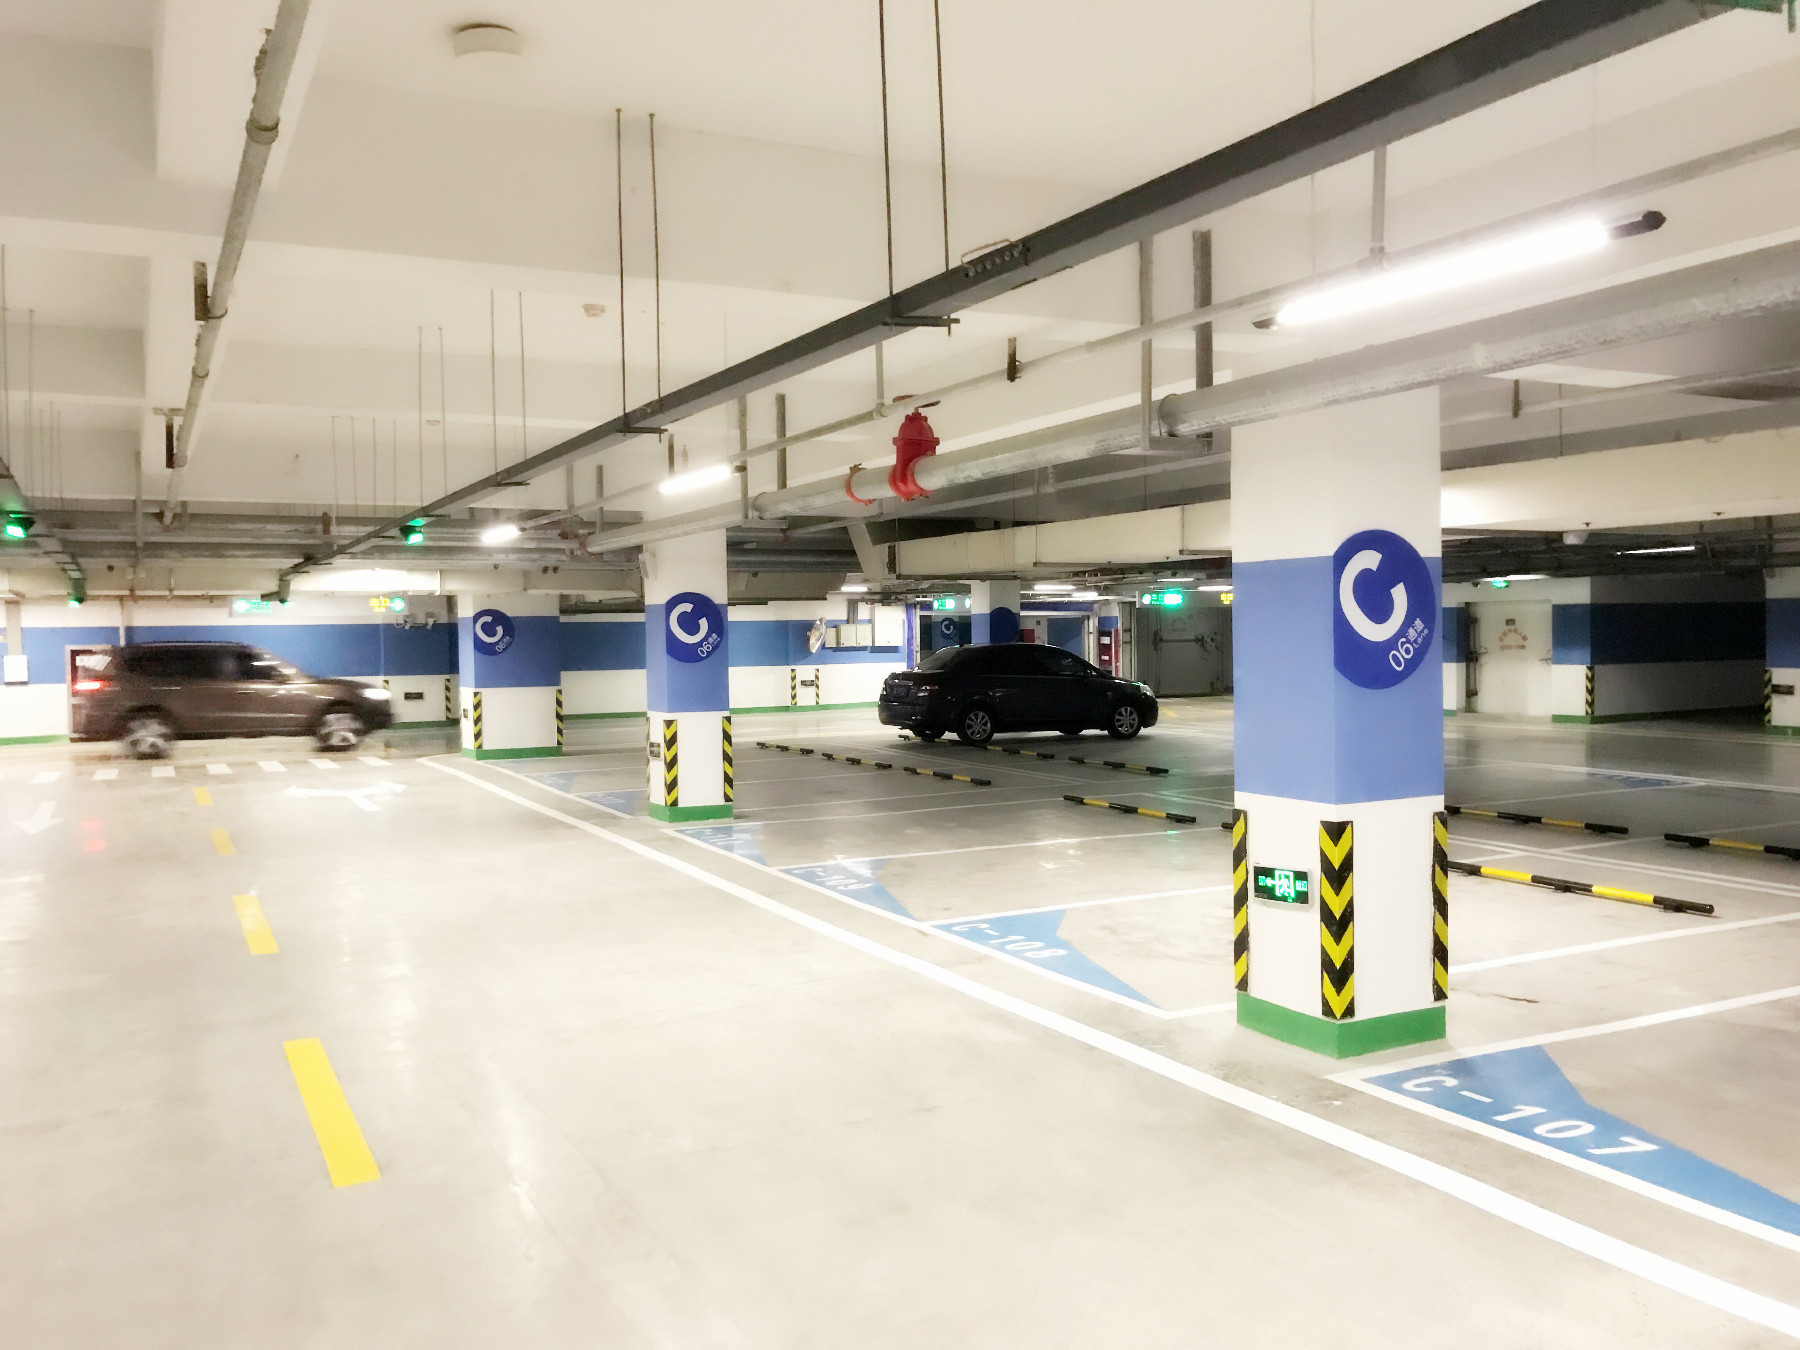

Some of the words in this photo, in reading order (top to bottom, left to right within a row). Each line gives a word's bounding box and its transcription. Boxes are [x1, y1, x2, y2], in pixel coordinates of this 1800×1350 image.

[1339, 549, 1408, 642] C
[475, 615, 504, 644] C
[669, 602, 709, 644] C
[941, 620, 954, 635] C
[1413, 627, 1429, 649] Lane
[697, 641, 713, 657] 06
[1388, 637, 1414, 672] 06
[791, 867, 872, 890] C-109
[951, 922, 1068, 959] C-108
[1401, 1075, 1660, 1155] C-107
